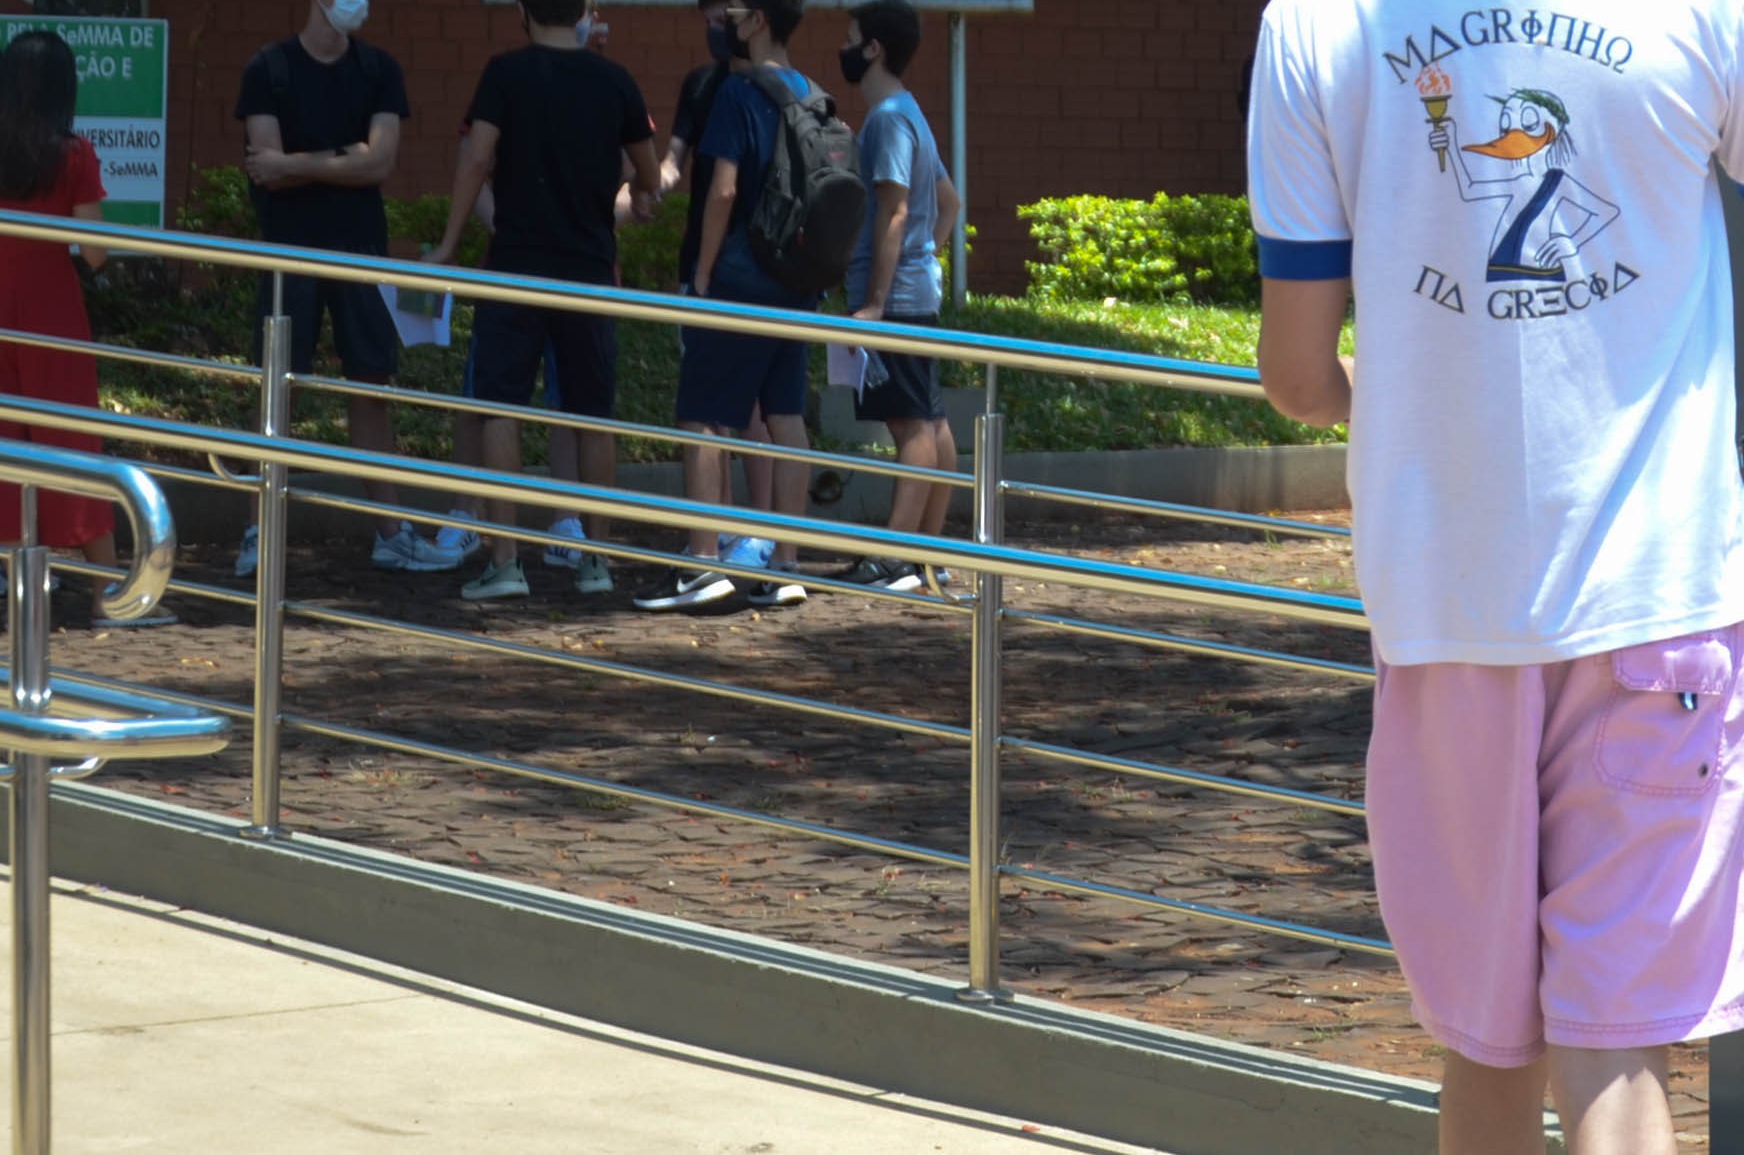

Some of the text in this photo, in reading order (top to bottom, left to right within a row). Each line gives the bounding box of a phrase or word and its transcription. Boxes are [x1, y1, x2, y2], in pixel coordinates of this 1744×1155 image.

[56, 23, 125, 48] SeMMA
[130, 26, 155, 48] DE
[75, 51, 133, 82] ÇÃO E
